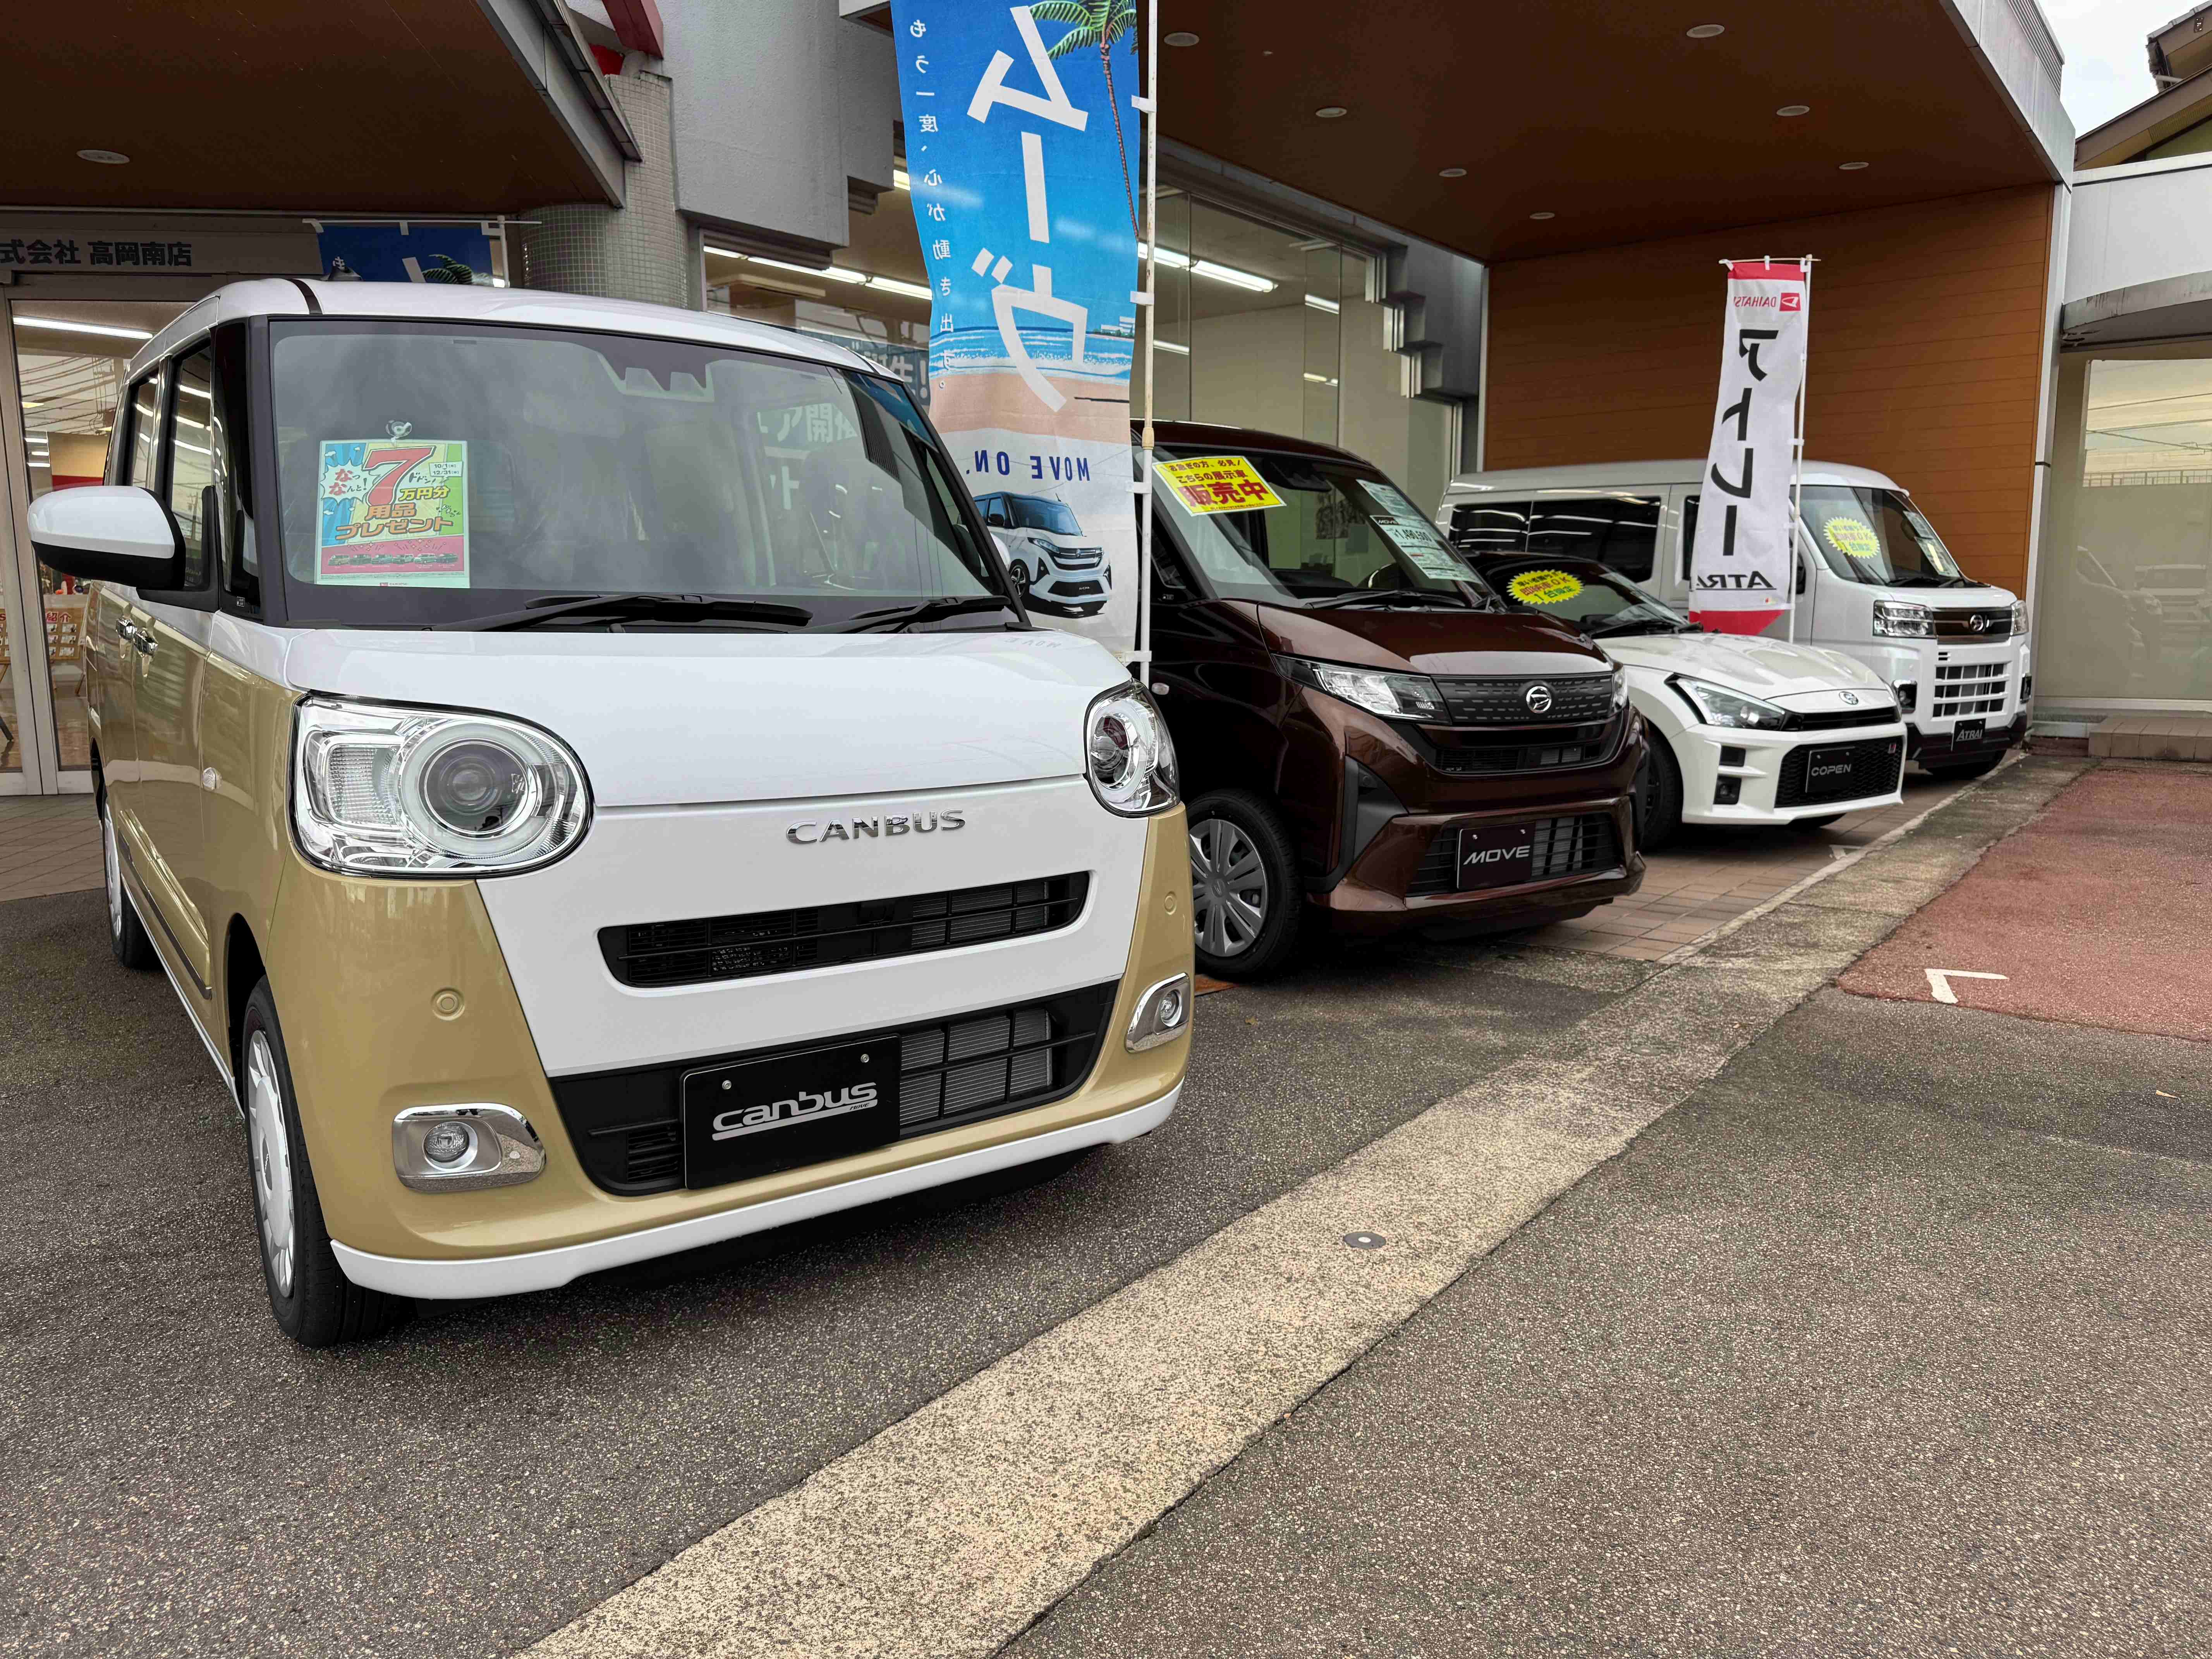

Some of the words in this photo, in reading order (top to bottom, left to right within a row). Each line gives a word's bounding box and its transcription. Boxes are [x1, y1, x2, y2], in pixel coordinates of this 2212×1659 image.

[87, 240, 192, 266] 高岡南店
[362, 446, 436, 507] 7
[398, 486, 451, 501] 万円分
[1177, 479, 1269, 507] 販売中
[365, 503, 417, 520] 用品
[336, 518, 453, 540] プレゼント
[1956, 728, 1983, 741] ATRAI
[1811, 764, 1851, 777] COPEN
[786, 809, 966, 844] CANBUS
[1463, 845, 1530, 865] MOVE
[713, 1082, 877, 1131] canbus
[850, 1102, 870, 1111] MOVE
